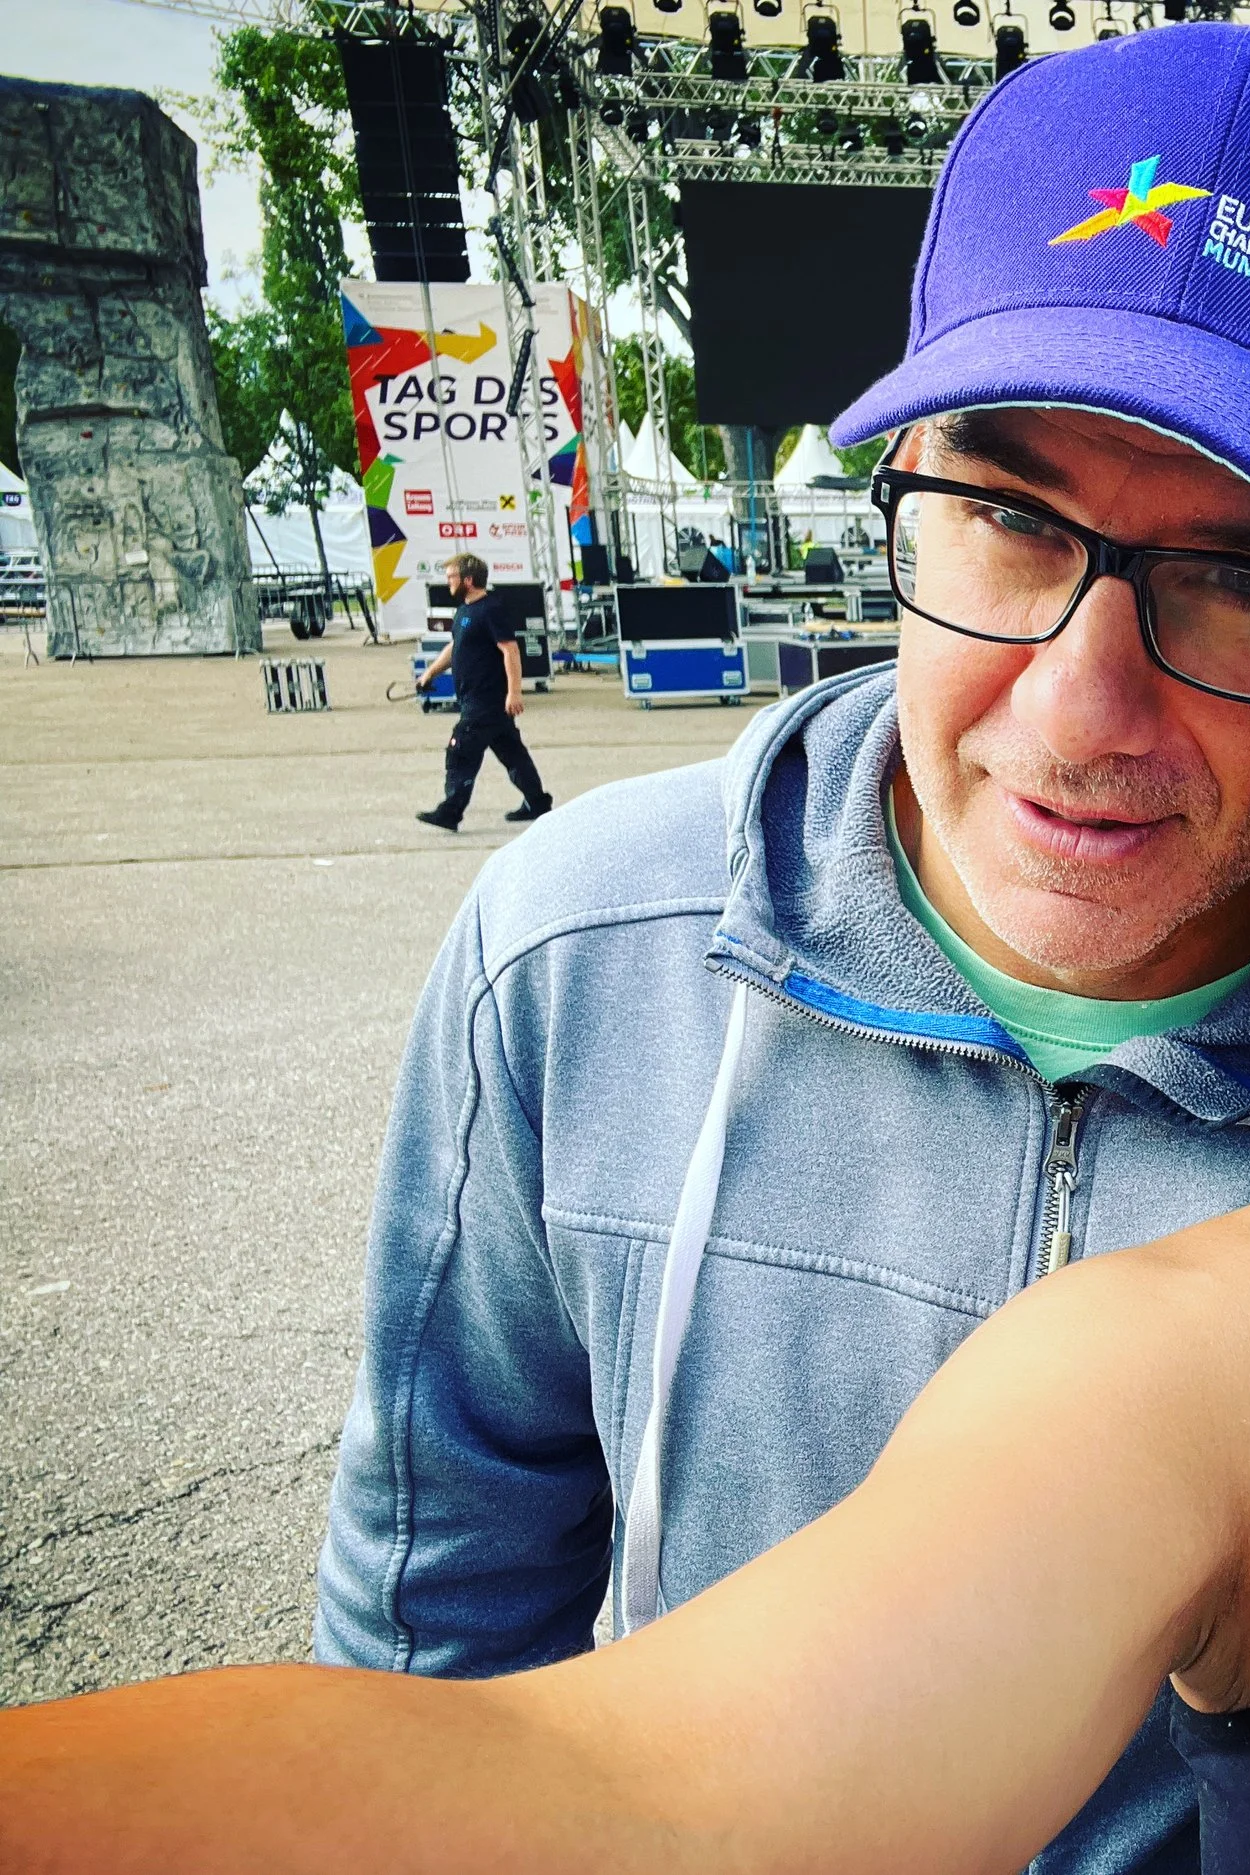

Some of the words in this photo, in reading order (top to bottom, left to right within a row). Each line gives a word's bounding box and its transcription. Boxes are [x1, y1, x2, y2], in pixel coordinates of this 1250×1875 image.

[373, 375, 456, 405] TAG
[474, 376, 559, 406] DS
[383, 411, 559, 442] SPORS
[441, 524, 475, 537] ORF
